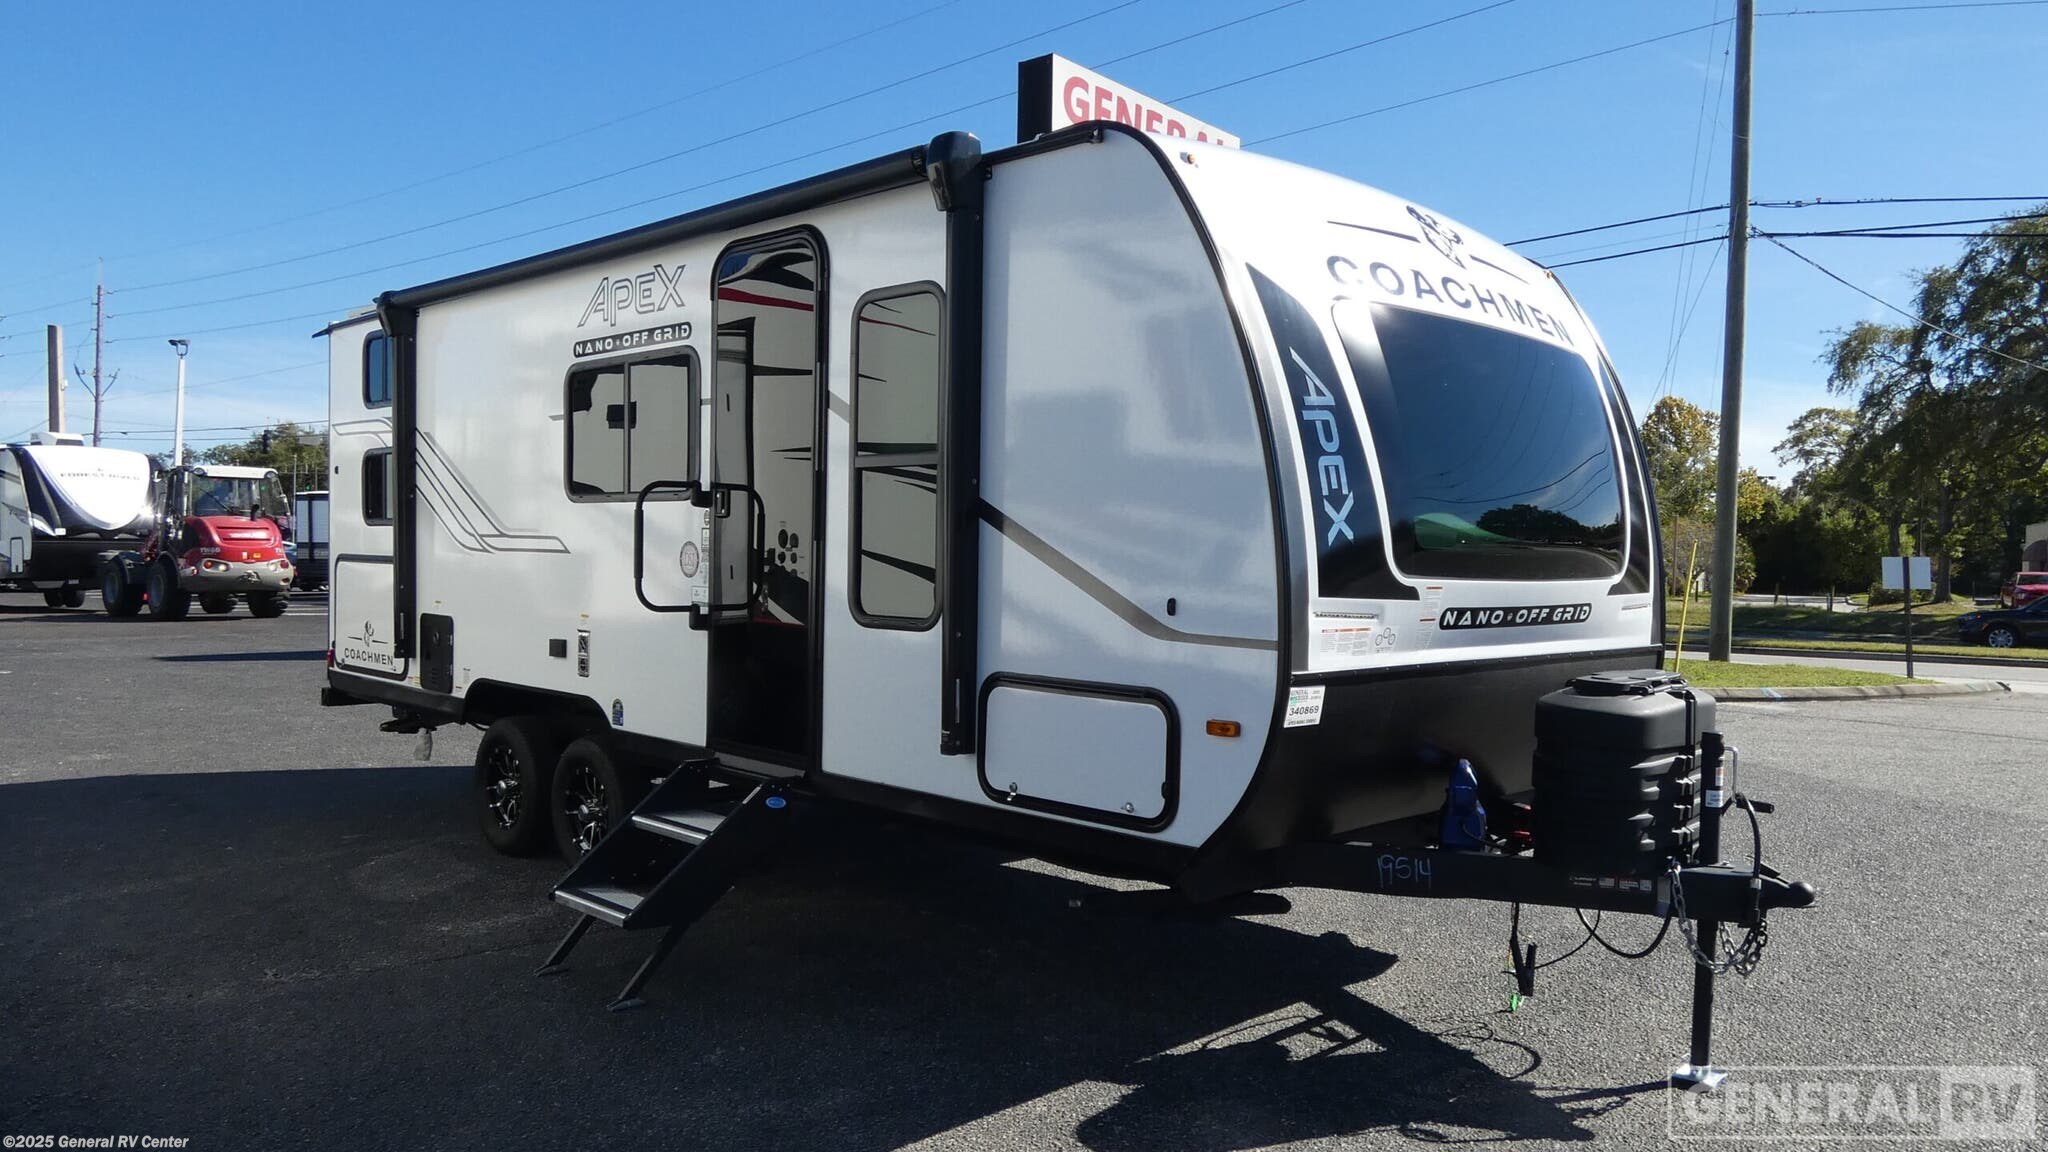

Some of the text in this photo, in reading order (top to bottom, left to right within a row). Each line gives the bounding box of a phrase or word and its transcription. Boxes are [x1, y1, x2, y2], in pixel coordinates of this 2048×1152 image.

[576, 264, 687, 328] APEX
[1326, 255, 1574, 347] COACHMEN
[575, 324, 690, 356] NANO OFF GRID
[1288, 346, 1355, 547] APEX
[1443, 606, 1590, 626] NANO OFF GRID
[344, 647, 394, 666] COACHMEN
[1289, 705, 1320, 716] 340869
